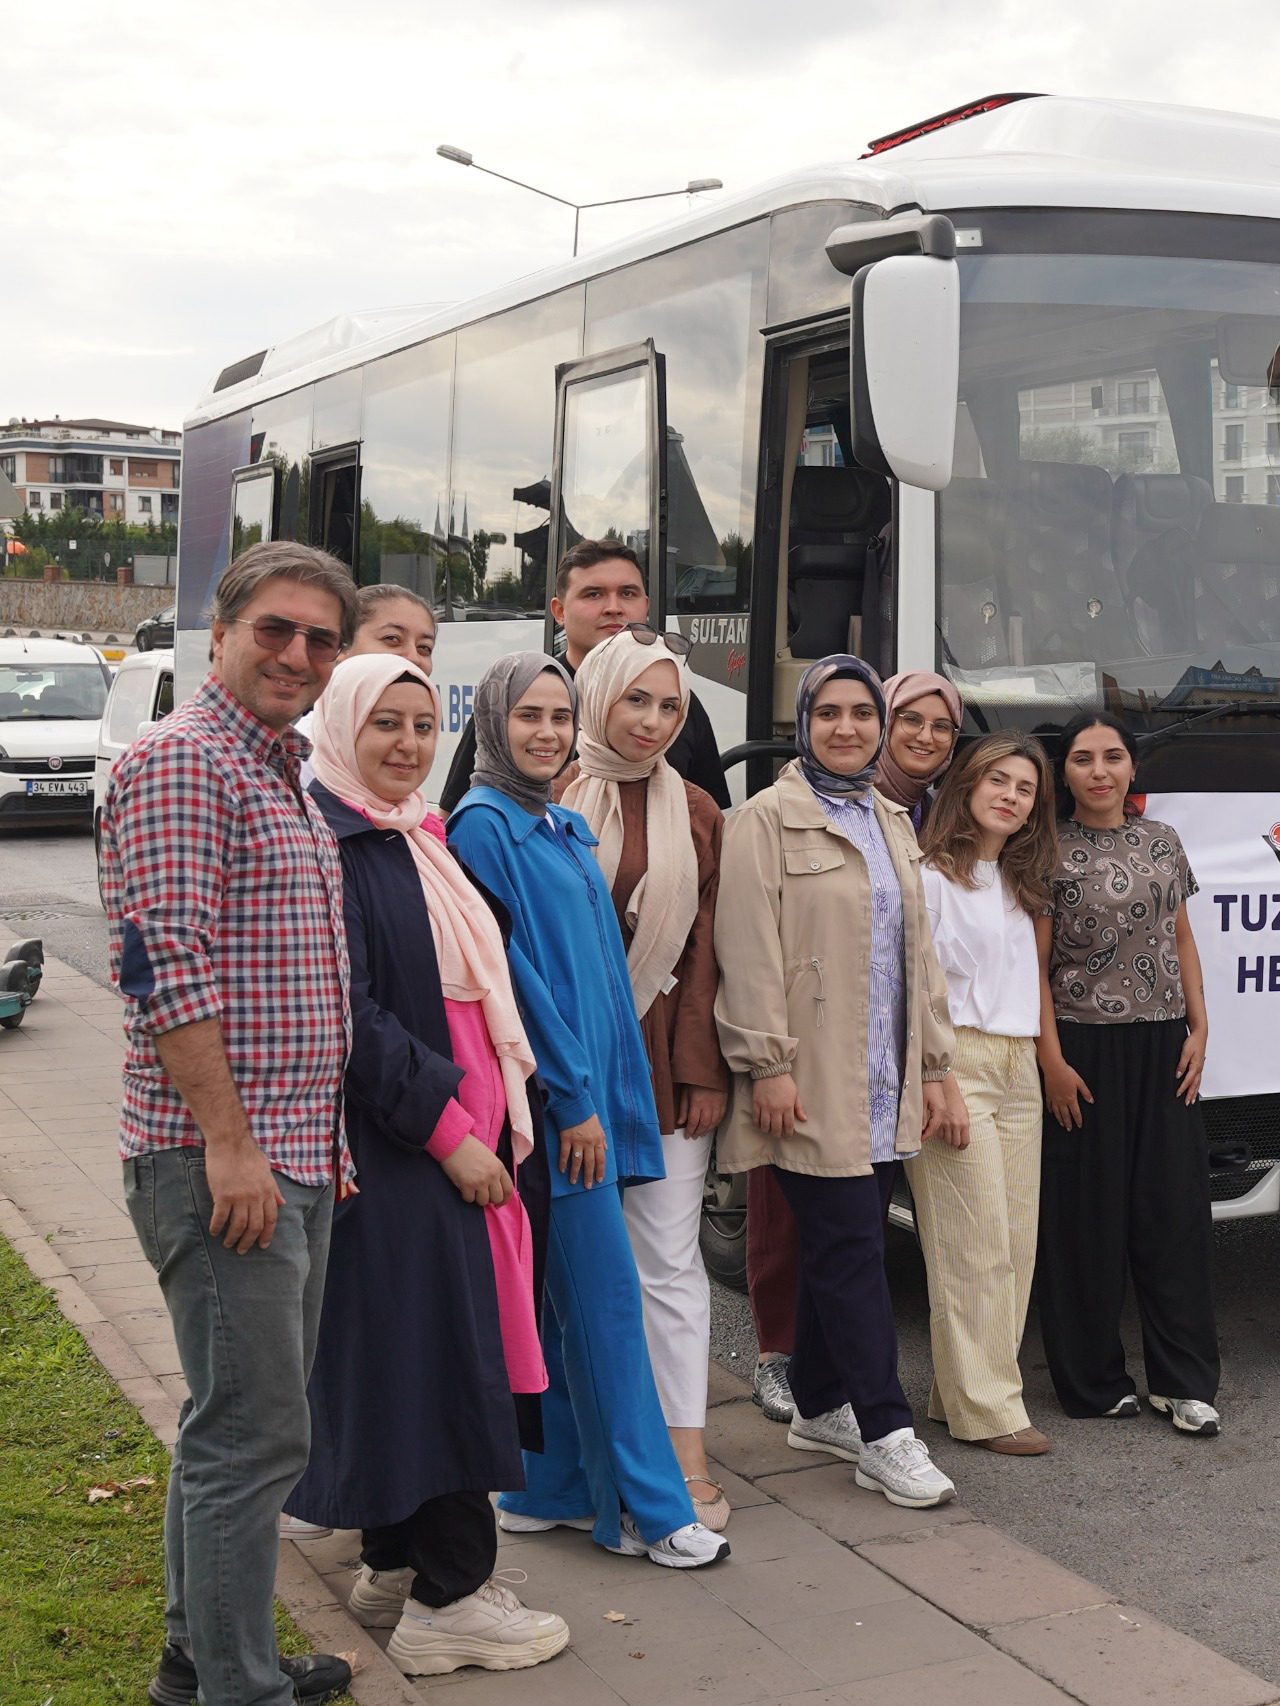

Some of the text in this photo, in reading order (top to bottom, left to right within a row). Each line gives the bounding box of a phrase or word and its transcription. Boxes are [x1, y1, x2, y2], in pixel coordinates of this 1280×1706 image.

[690, 618, 748, 644] SULTAN
[33, 783, 85, 792] 34 EVA 443
